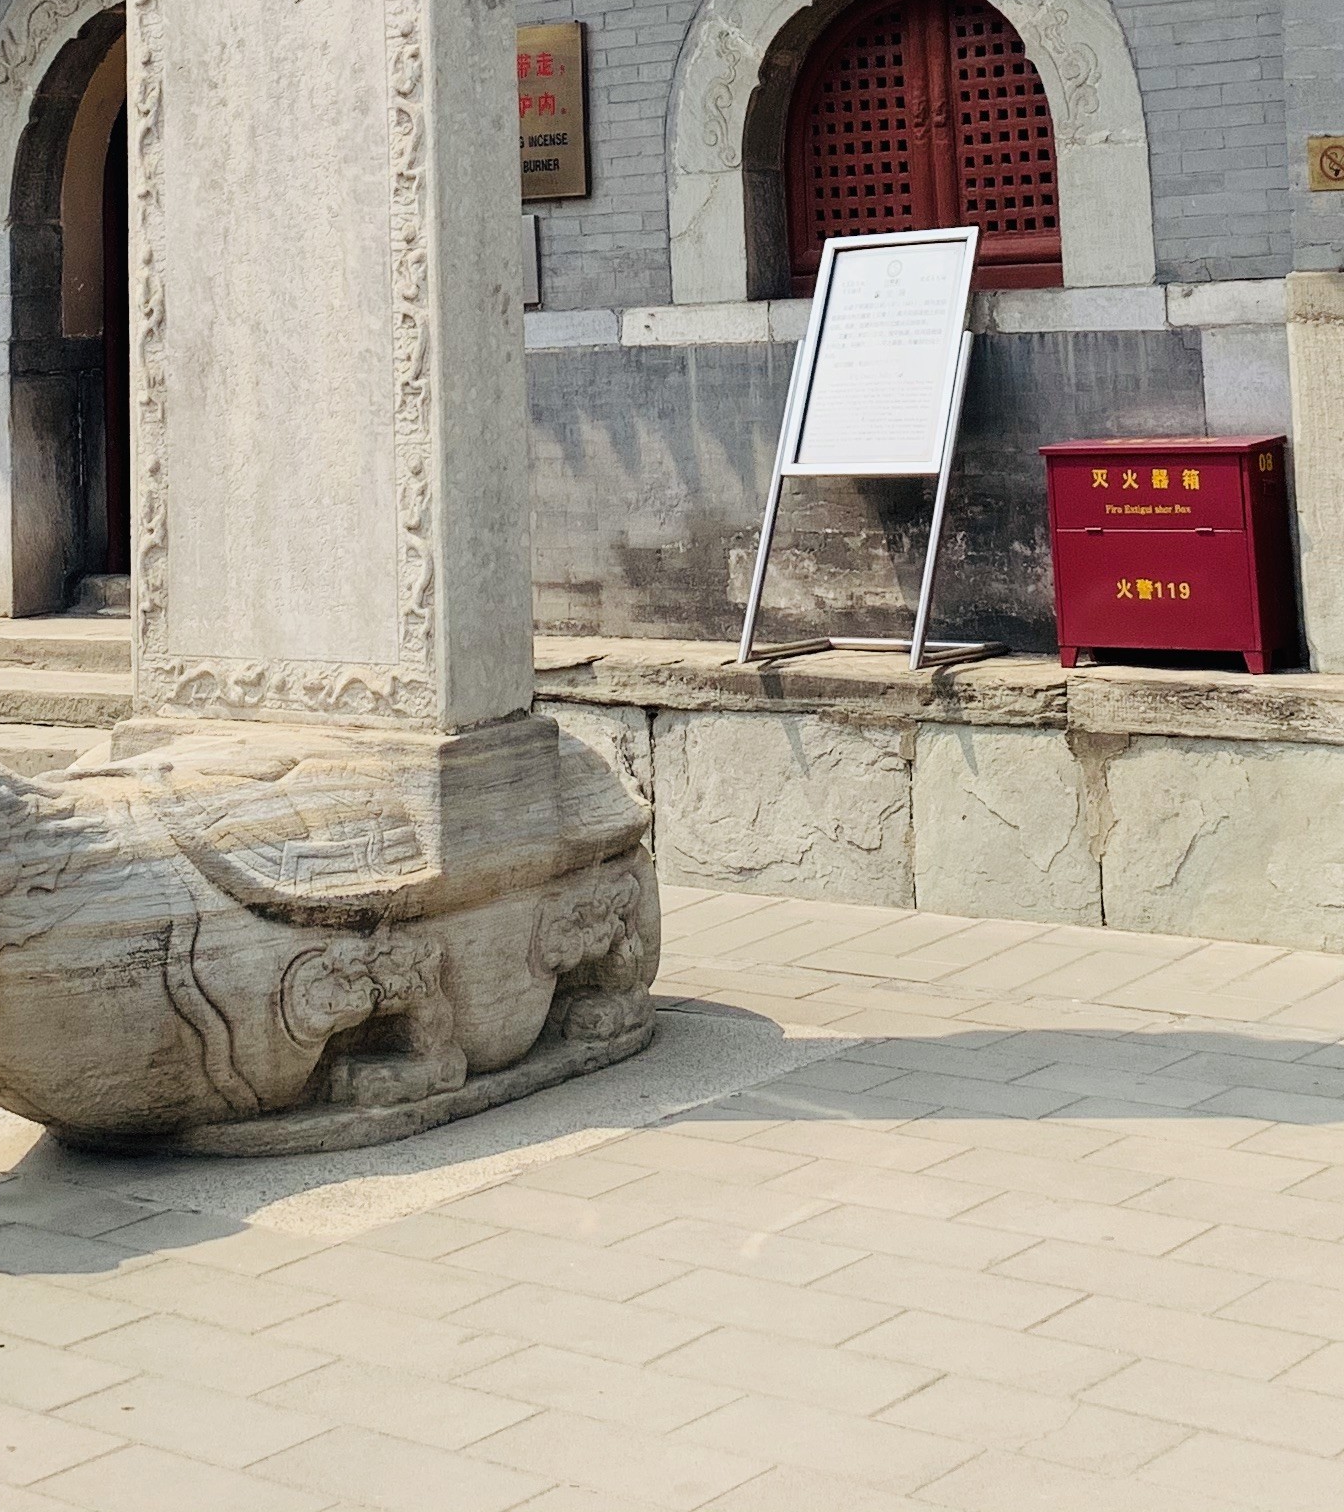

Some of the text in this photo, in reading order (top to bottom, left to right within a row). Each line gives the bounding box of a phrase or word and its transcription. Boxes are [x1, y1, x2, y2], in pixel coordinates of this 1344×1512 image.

[529, 132, 568, 148] INCENSE
[523, 157, 560, 173] BURNER
[1091, 469, 1200, 490] 灭火器箱
[1105, 504, 1123, 514] Fire
[1175, 504, 1192, 514] Box
[1116, 579, 1190, 600] 火警119
